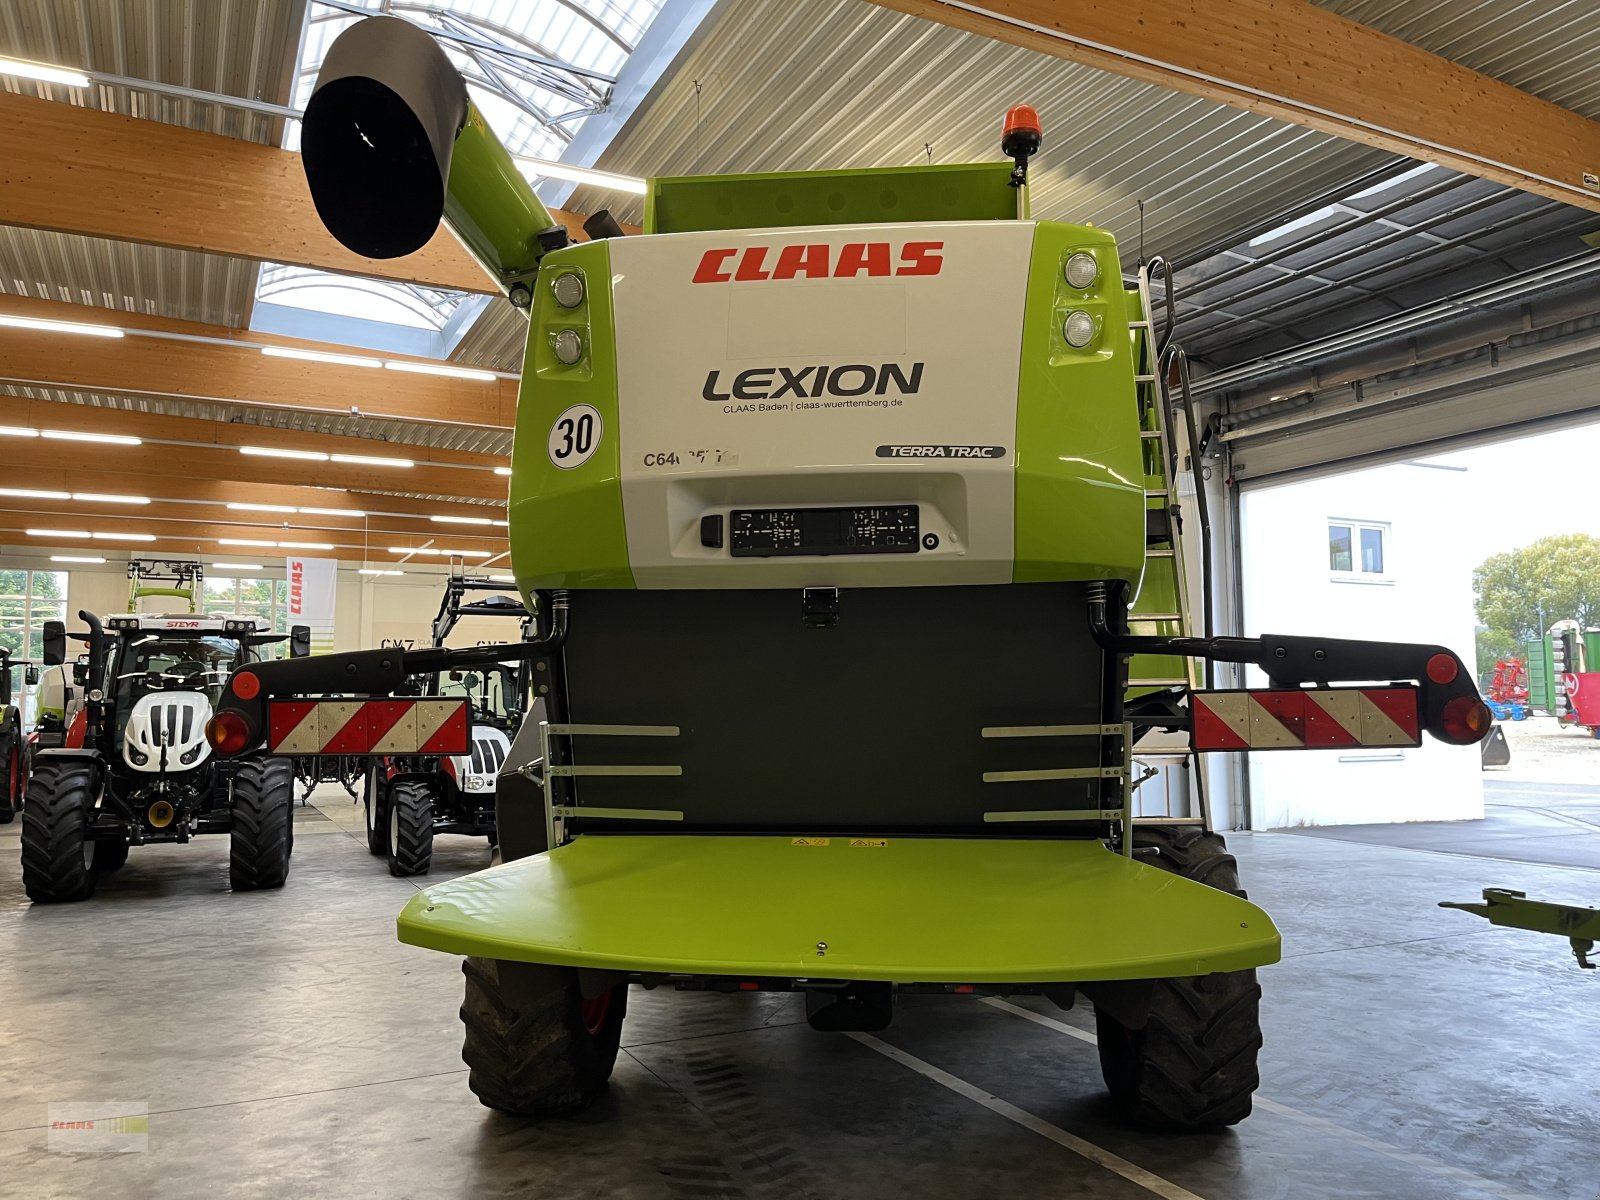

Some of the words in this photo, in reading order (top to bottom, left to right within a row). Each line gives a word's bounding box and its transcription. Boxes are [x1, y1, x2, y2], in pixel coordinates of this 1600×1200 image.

[693, 242, 944, 283] CLAAS
[702, 363, 924, 401] LEXION
[723, 404, 756, 414] CLAAS
[758, 402, 789, 412] Baden
[796, 399, 904, 411] claas-wuerttemberg.de
[557, 412, 595, 457] 30
[890, 446, 946, 457] TERRA
[949, 447, 994, 458] TRAC
[290, 561, 303, 615] CLAAS
